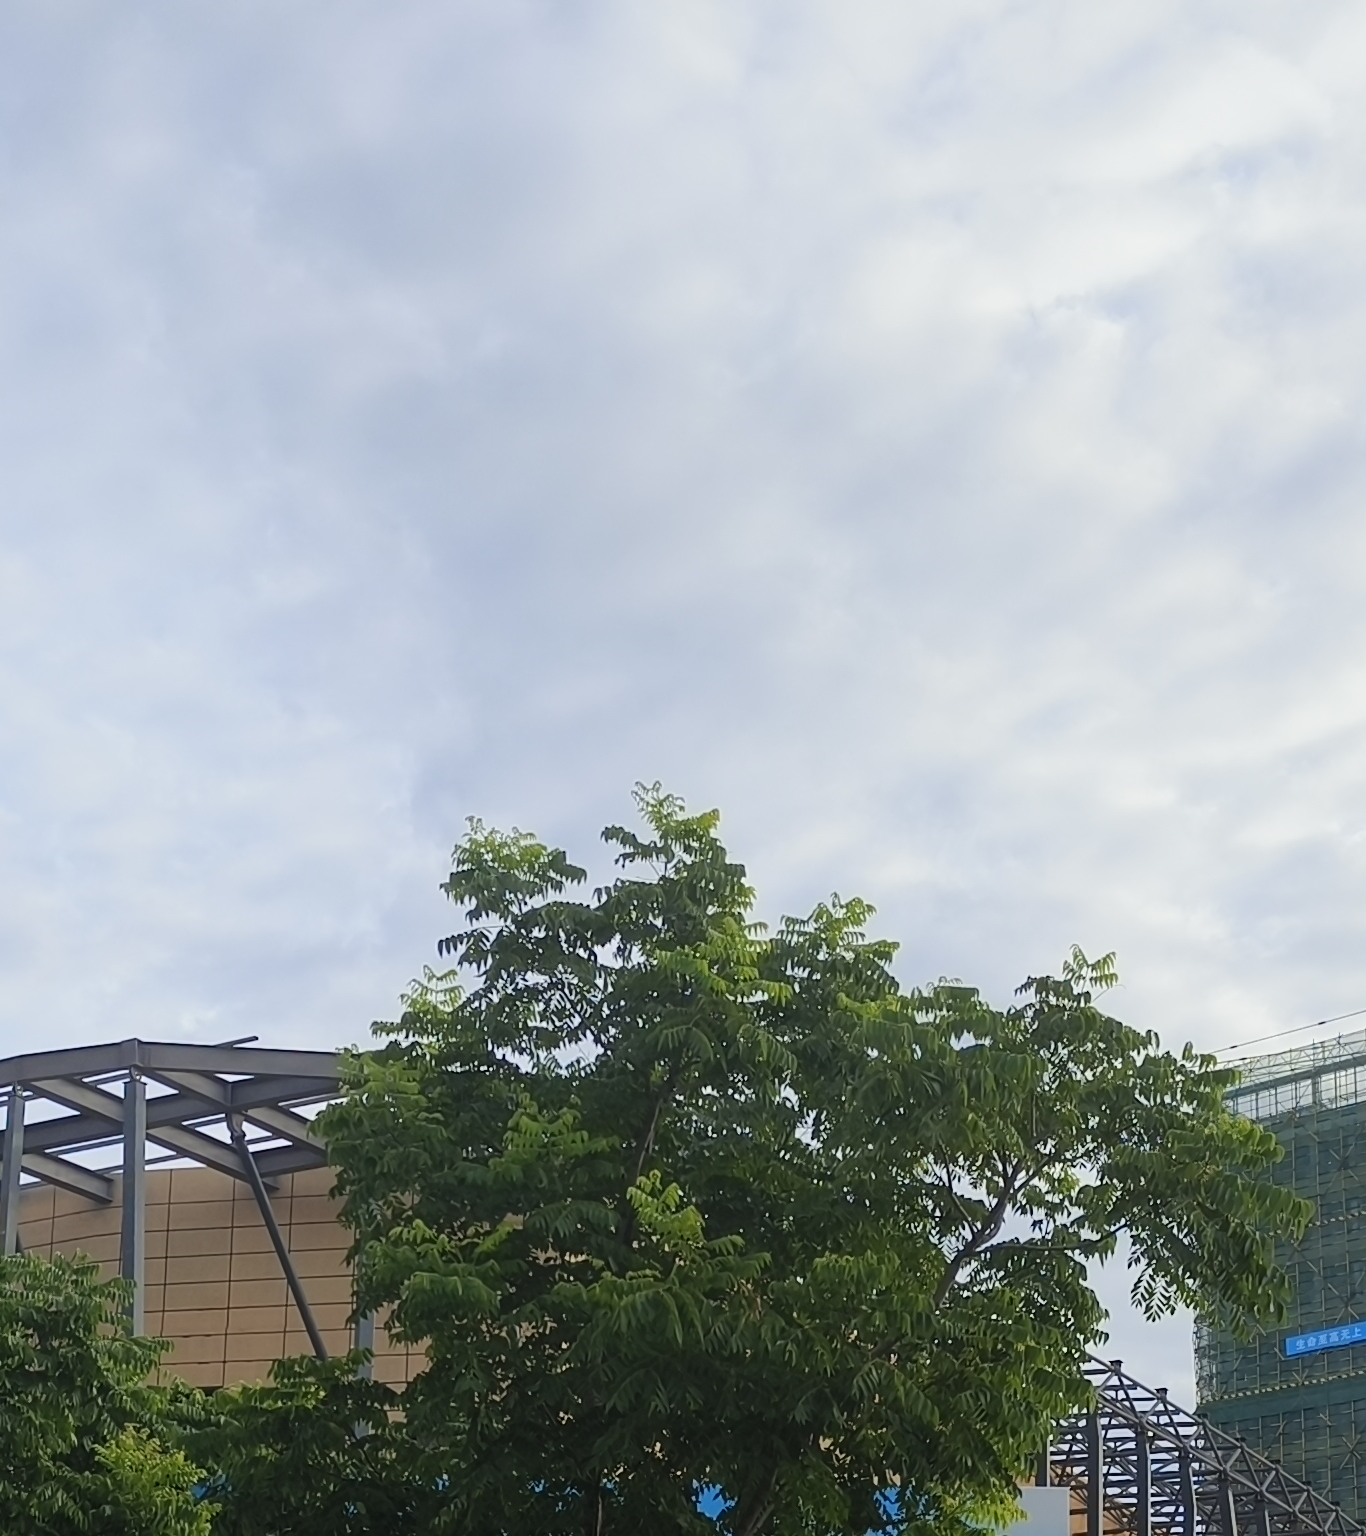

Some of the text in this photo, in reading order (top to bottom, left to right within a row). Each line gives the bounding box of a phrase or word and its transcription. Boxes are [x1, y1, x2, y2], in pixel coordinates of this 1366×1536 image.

[1296, 1326, 1362, 1351] 生命至高无上
